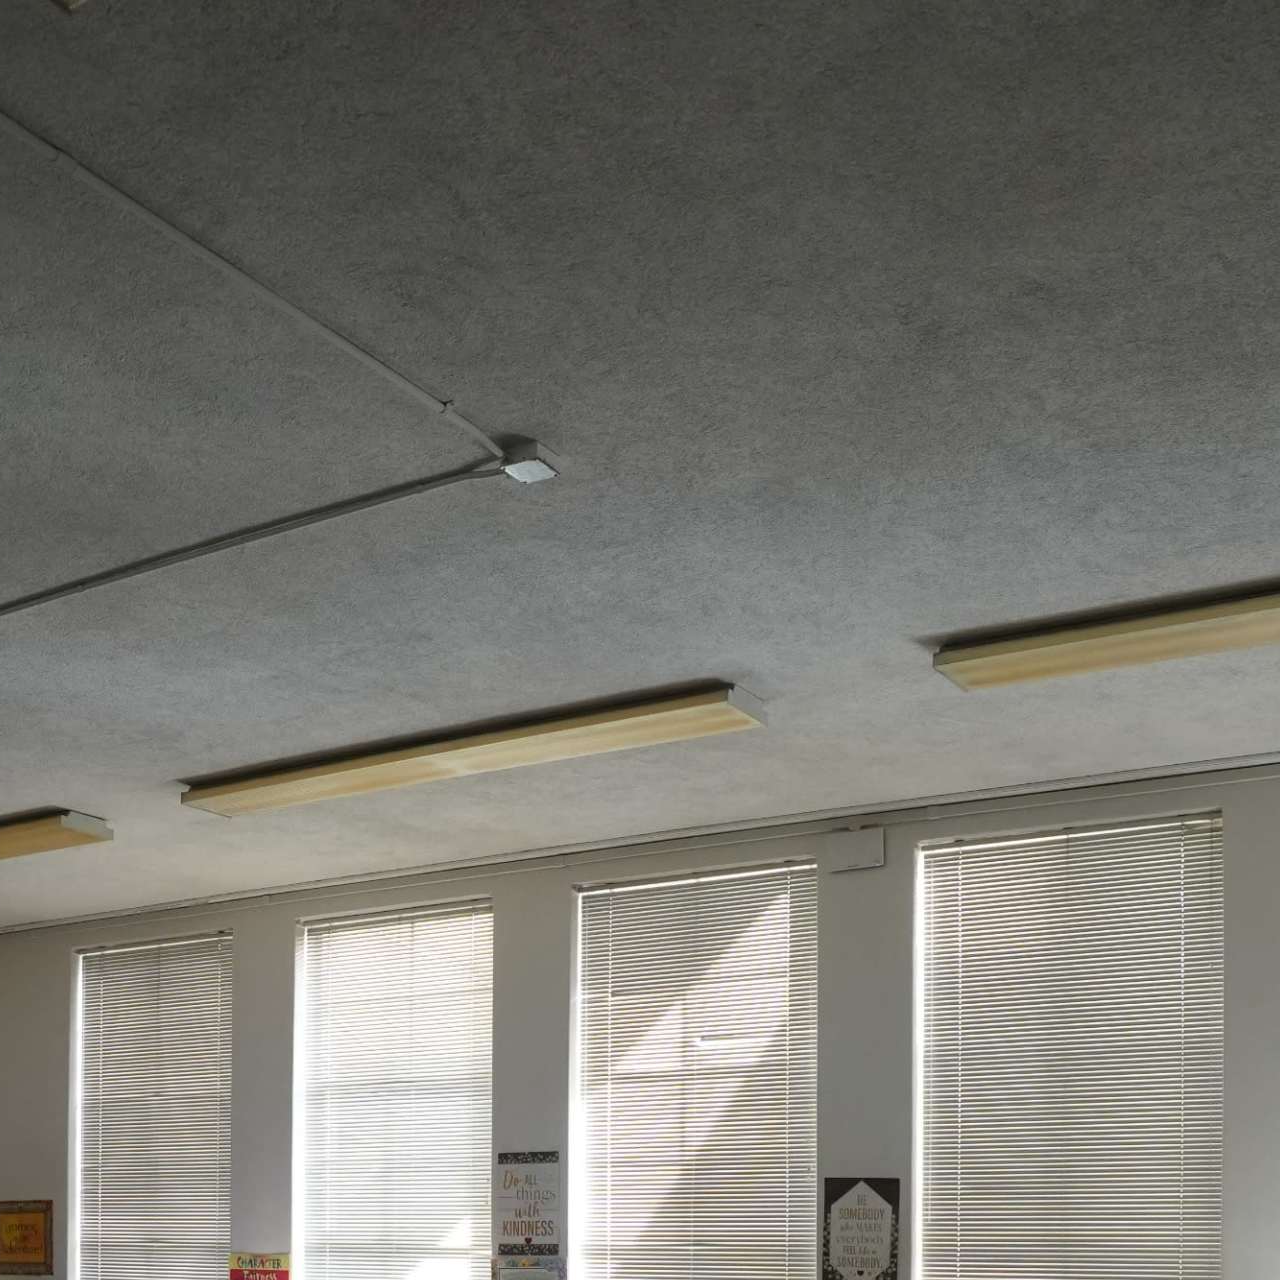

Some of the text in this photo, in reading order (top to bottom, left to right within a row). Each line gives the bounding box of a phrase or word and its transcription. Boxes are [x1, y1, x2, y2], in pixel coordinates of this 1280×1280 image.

[504, 1169, 519, 1190] Do
[516, 1186, 556, 1202] things
[514, 1201, 545, 1218] with
[502, 1220, 554, 1237] KINDNESS
[236, 1256, 282, 1269] CHARACTER
